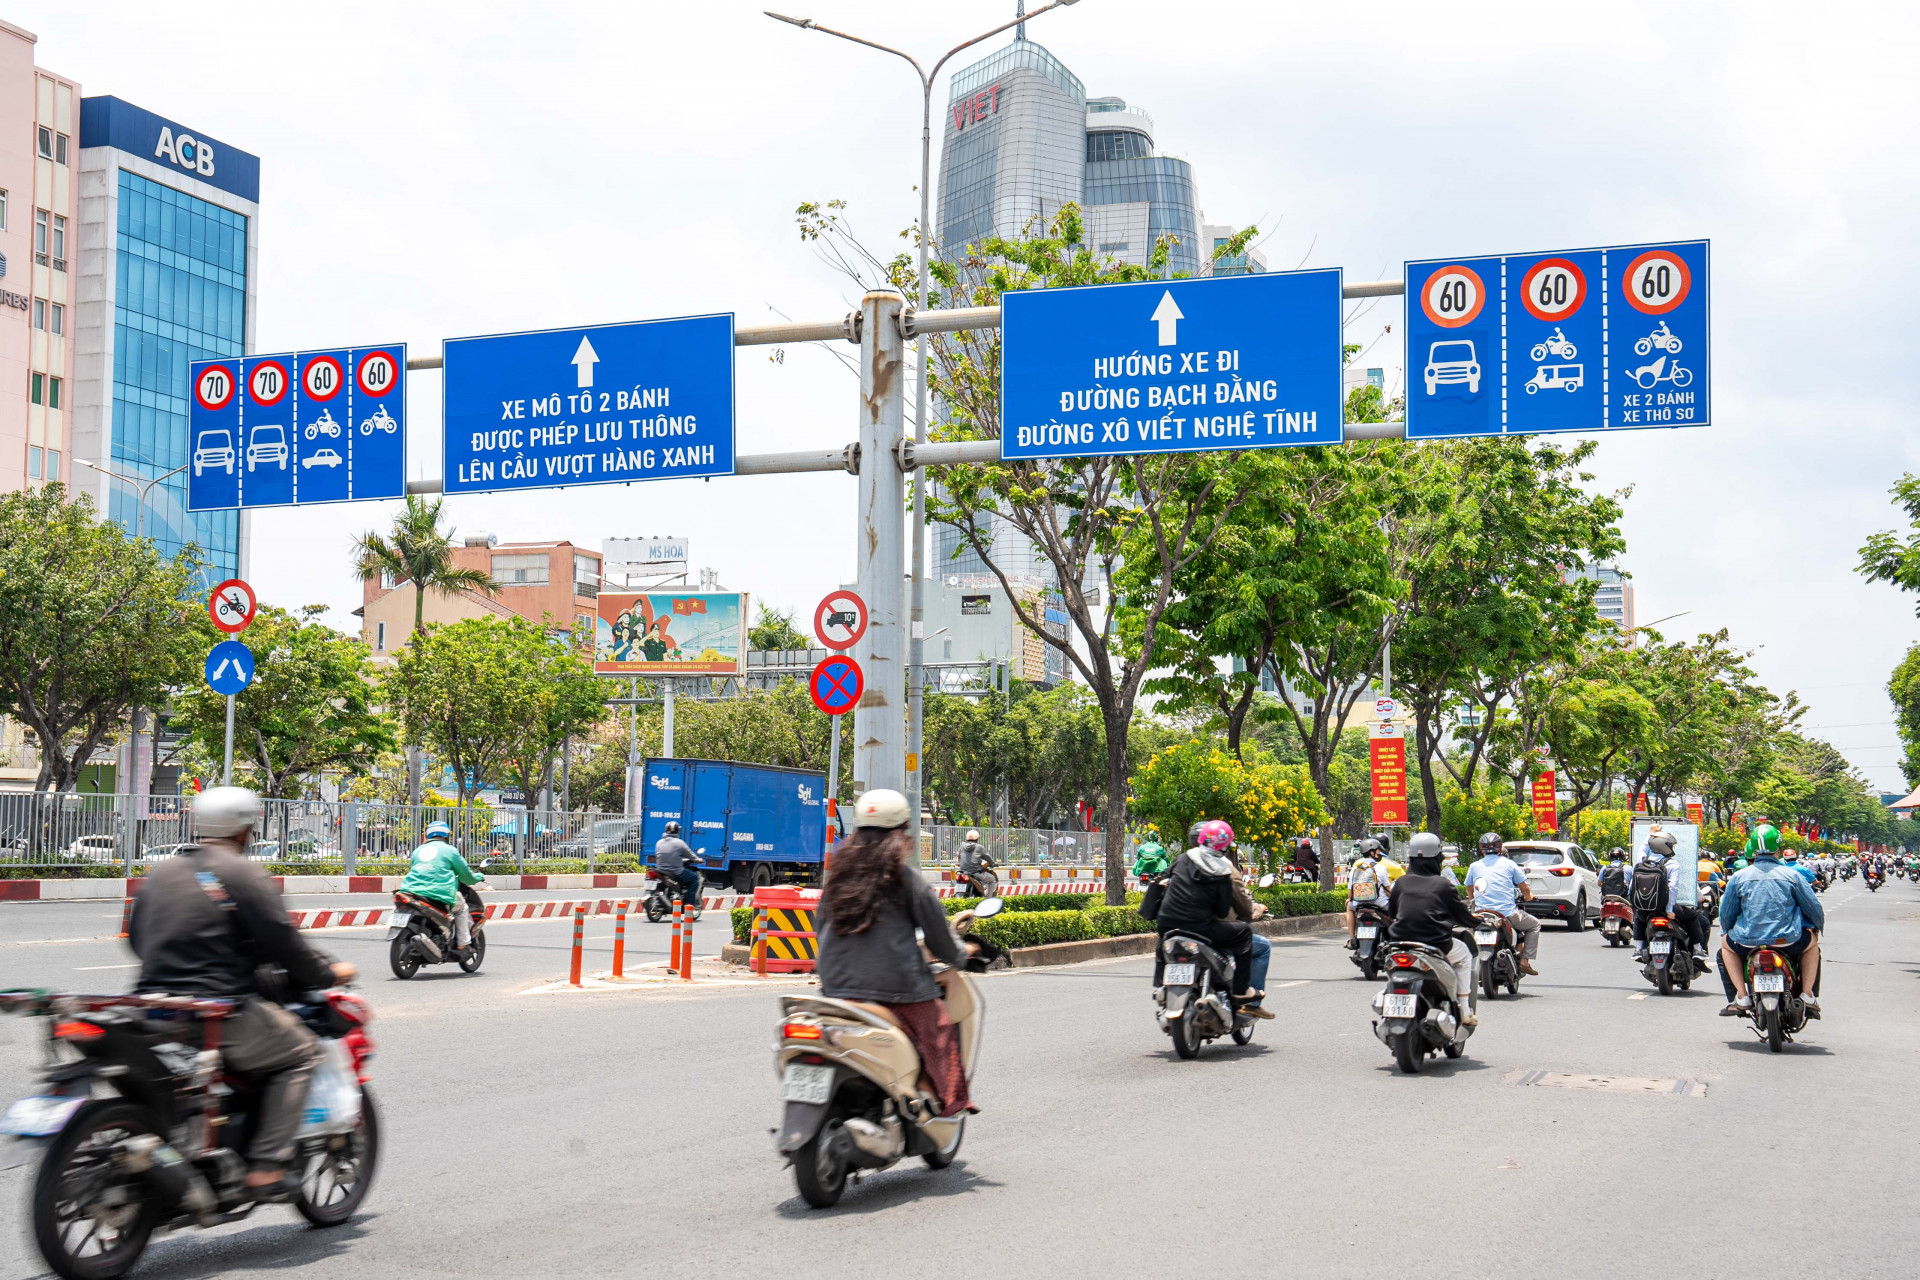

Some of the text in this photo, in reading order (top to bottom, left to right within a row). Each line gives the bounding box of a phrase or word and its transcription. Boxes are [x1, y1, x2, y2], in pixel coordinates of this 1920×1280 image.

[952, 84, 1000, 130] VIET
[154, 126, 215, 177] ACB
[1439, 280, 1466, 313] 60
[1539, 273, 1567, 306] 60
[1642, 265, 1670, 299] 60
[314, 366, 331, 391] 60
[368, 361, 386, 386] 60
[1094, 349, 1239, 379] HƯỚNG XE ĐI
[206, 375, 224, 399] 70
[259, 371, 277, 395] 70
[1059, 374, 1277, 412] ĐƯỜNG BẠCH ĐẰNG
[1623, 389, 1695, 407] XE 2 BÁNH
[501, 385, 670, 421] XE MÔ TÔ 2 BÁNH
[1623, 406, 1695, 423] XE THÔ SƠ
[470, 414, 697, 453] ĐƯỢC PHÉP LƯU THÔNG
[1016, 409, 1317, 447] ĐƯỜNG XÔ VIẾT NGHỆ TĨNH
[459, 445, 714, 483] LÊN CẦU VƯỢT HÀNG XANH
[649, 545, 684, 559] MS HOA
[693, 820, 724, 829] SAGAWA
[732, 832, 754, 842] SAGAWA
